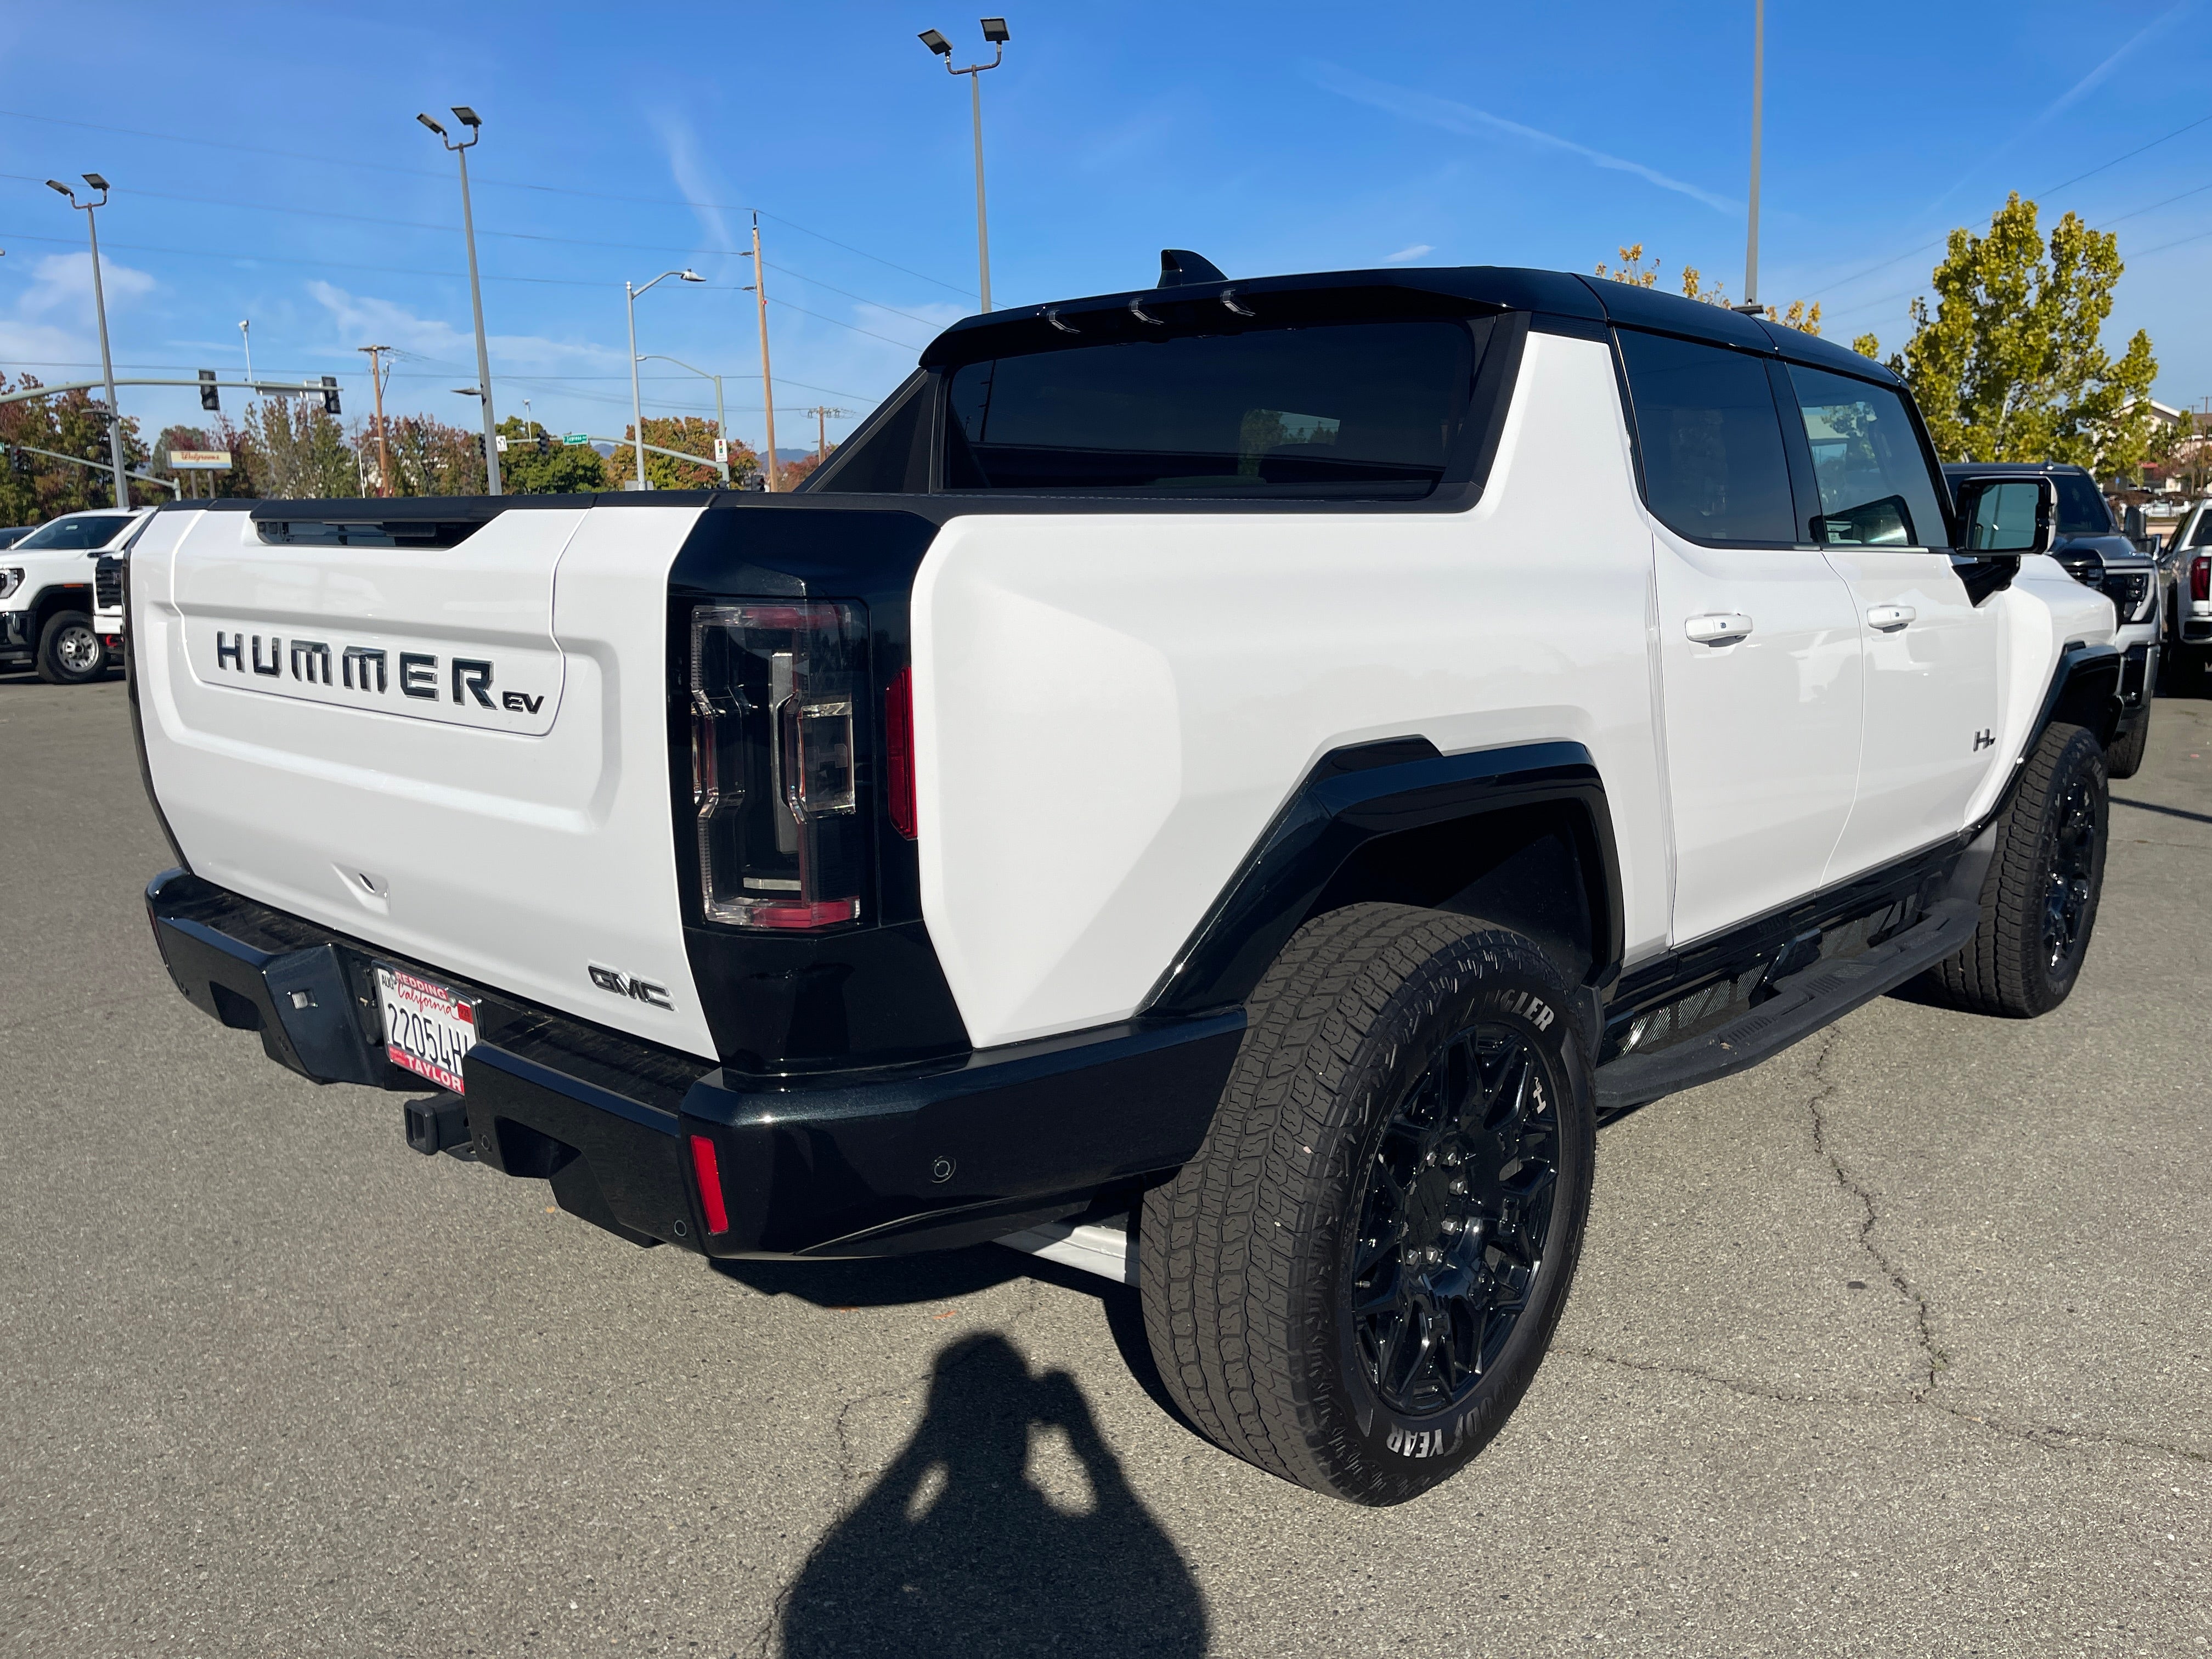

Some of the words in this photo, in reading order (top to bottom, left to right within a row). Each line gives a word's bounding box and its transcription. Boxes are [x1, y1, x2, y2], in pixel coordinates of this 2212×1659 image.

[217, 631, 499, 710] HUMMER
[502, 691, 544, 714] EV
[395, 971, 448, 1001] REDDING
[398, 983, 460, 1020] California
[588, 966, 675, 1012] GMC
[405, 1054, 463, 1092] TAYLOR
